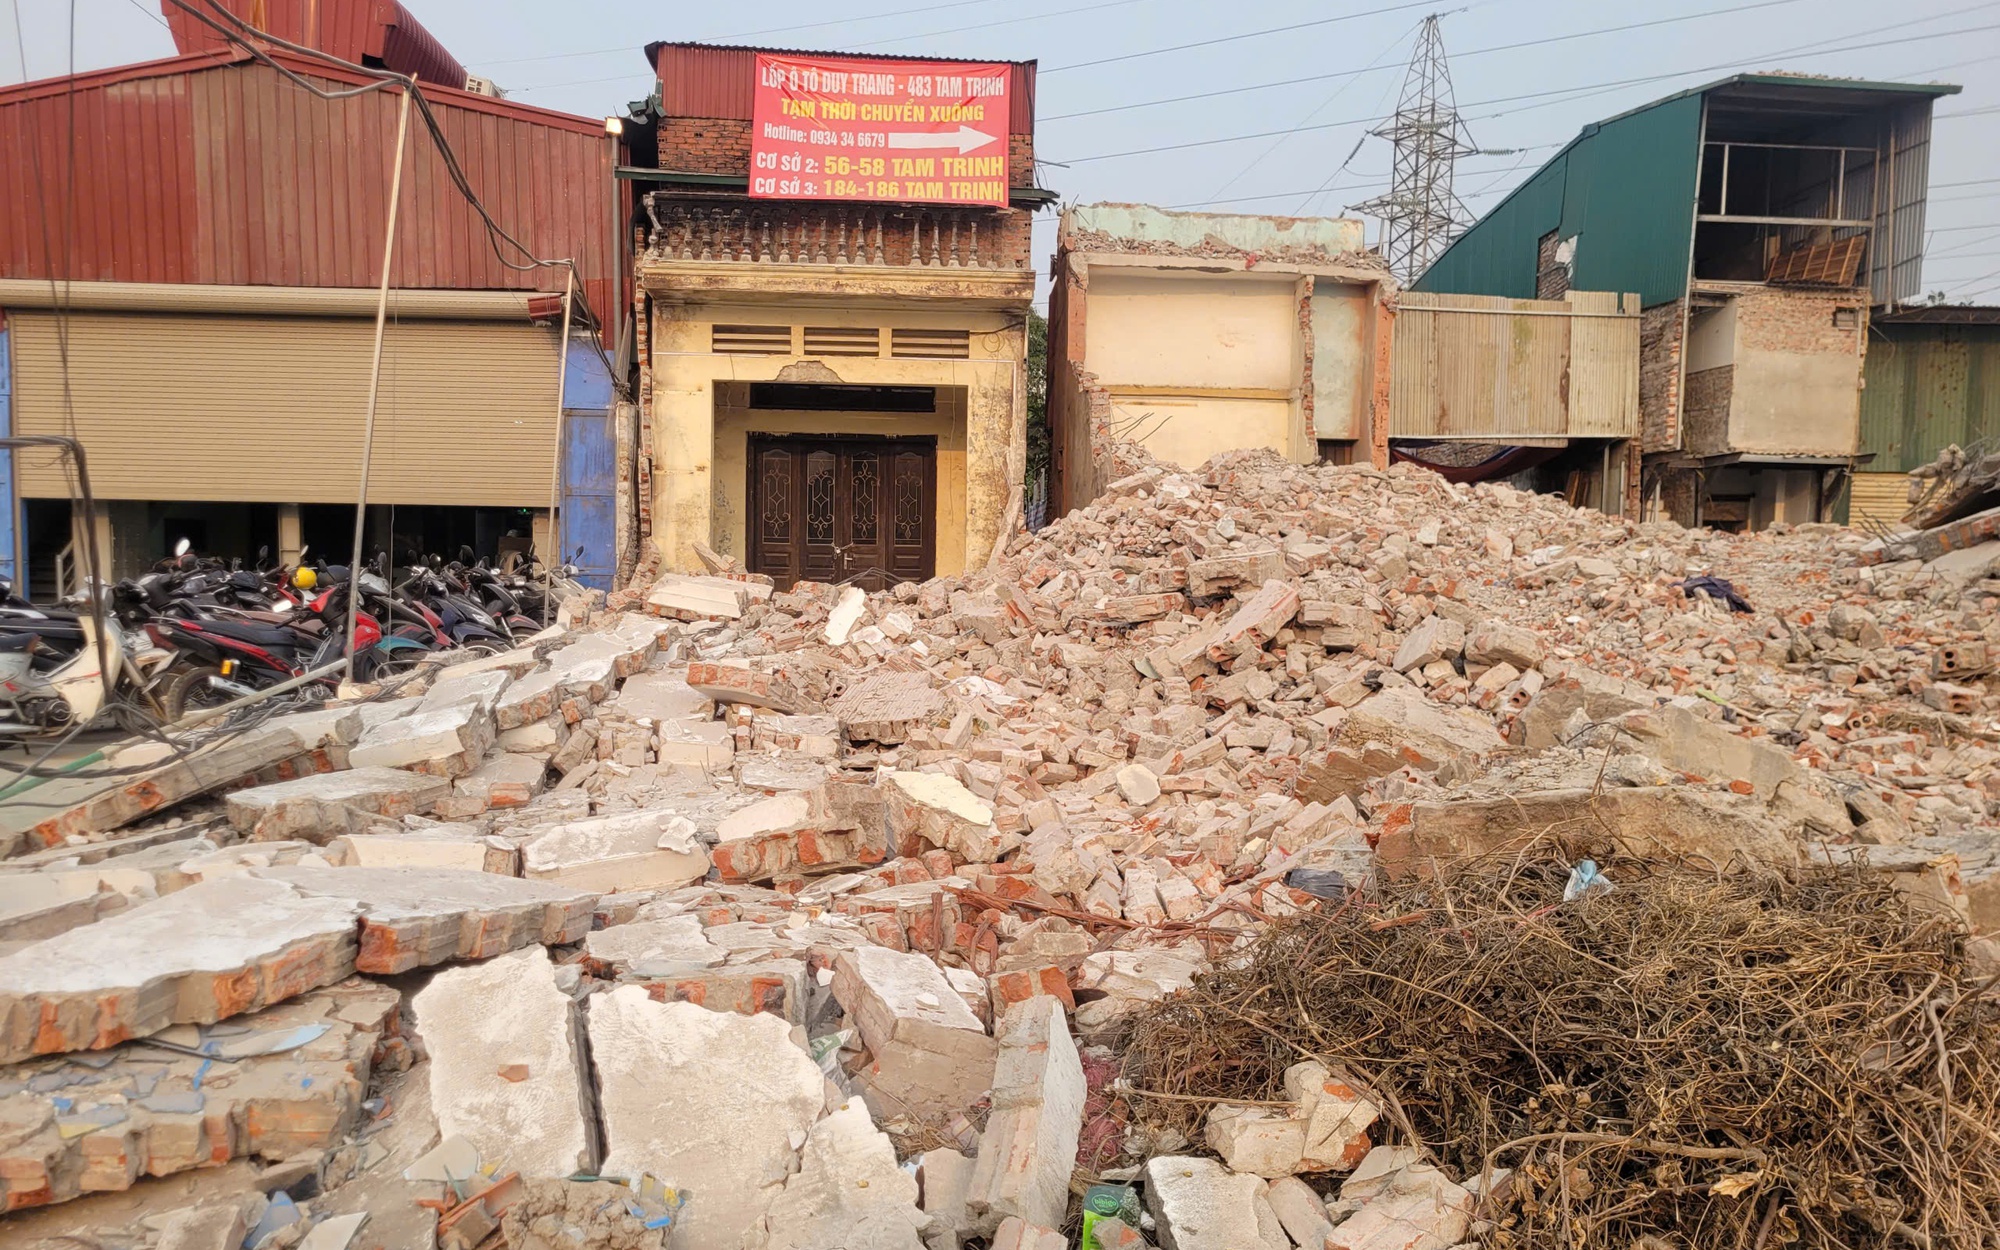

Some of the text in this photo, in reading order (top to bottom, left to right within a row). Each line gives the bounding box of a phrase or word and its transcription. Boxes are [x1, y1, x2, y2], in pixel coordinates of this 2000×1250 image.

[802, 67, 818, 92] TÔ
[822, 72, 848, 94] DUY
[852, 73, 894, 96] TRANG
[907, 76, 931, 97] 483
[935, 76, 962, 97] TAM
[966, 77, 1004, 97] TRINH
[781, 98, 984, 122] TẠM THỜI CHUYỂN XUỐNG
[764, 122, 885, 148] Hotline: 0934 34 6679
[756, 151, 1004, 177] CƠ SỞ 2: 56-58 TAM TRINH
[755, 176, 1004, 203] CƠ SỞ 3: 184-186 TAM TRINH
